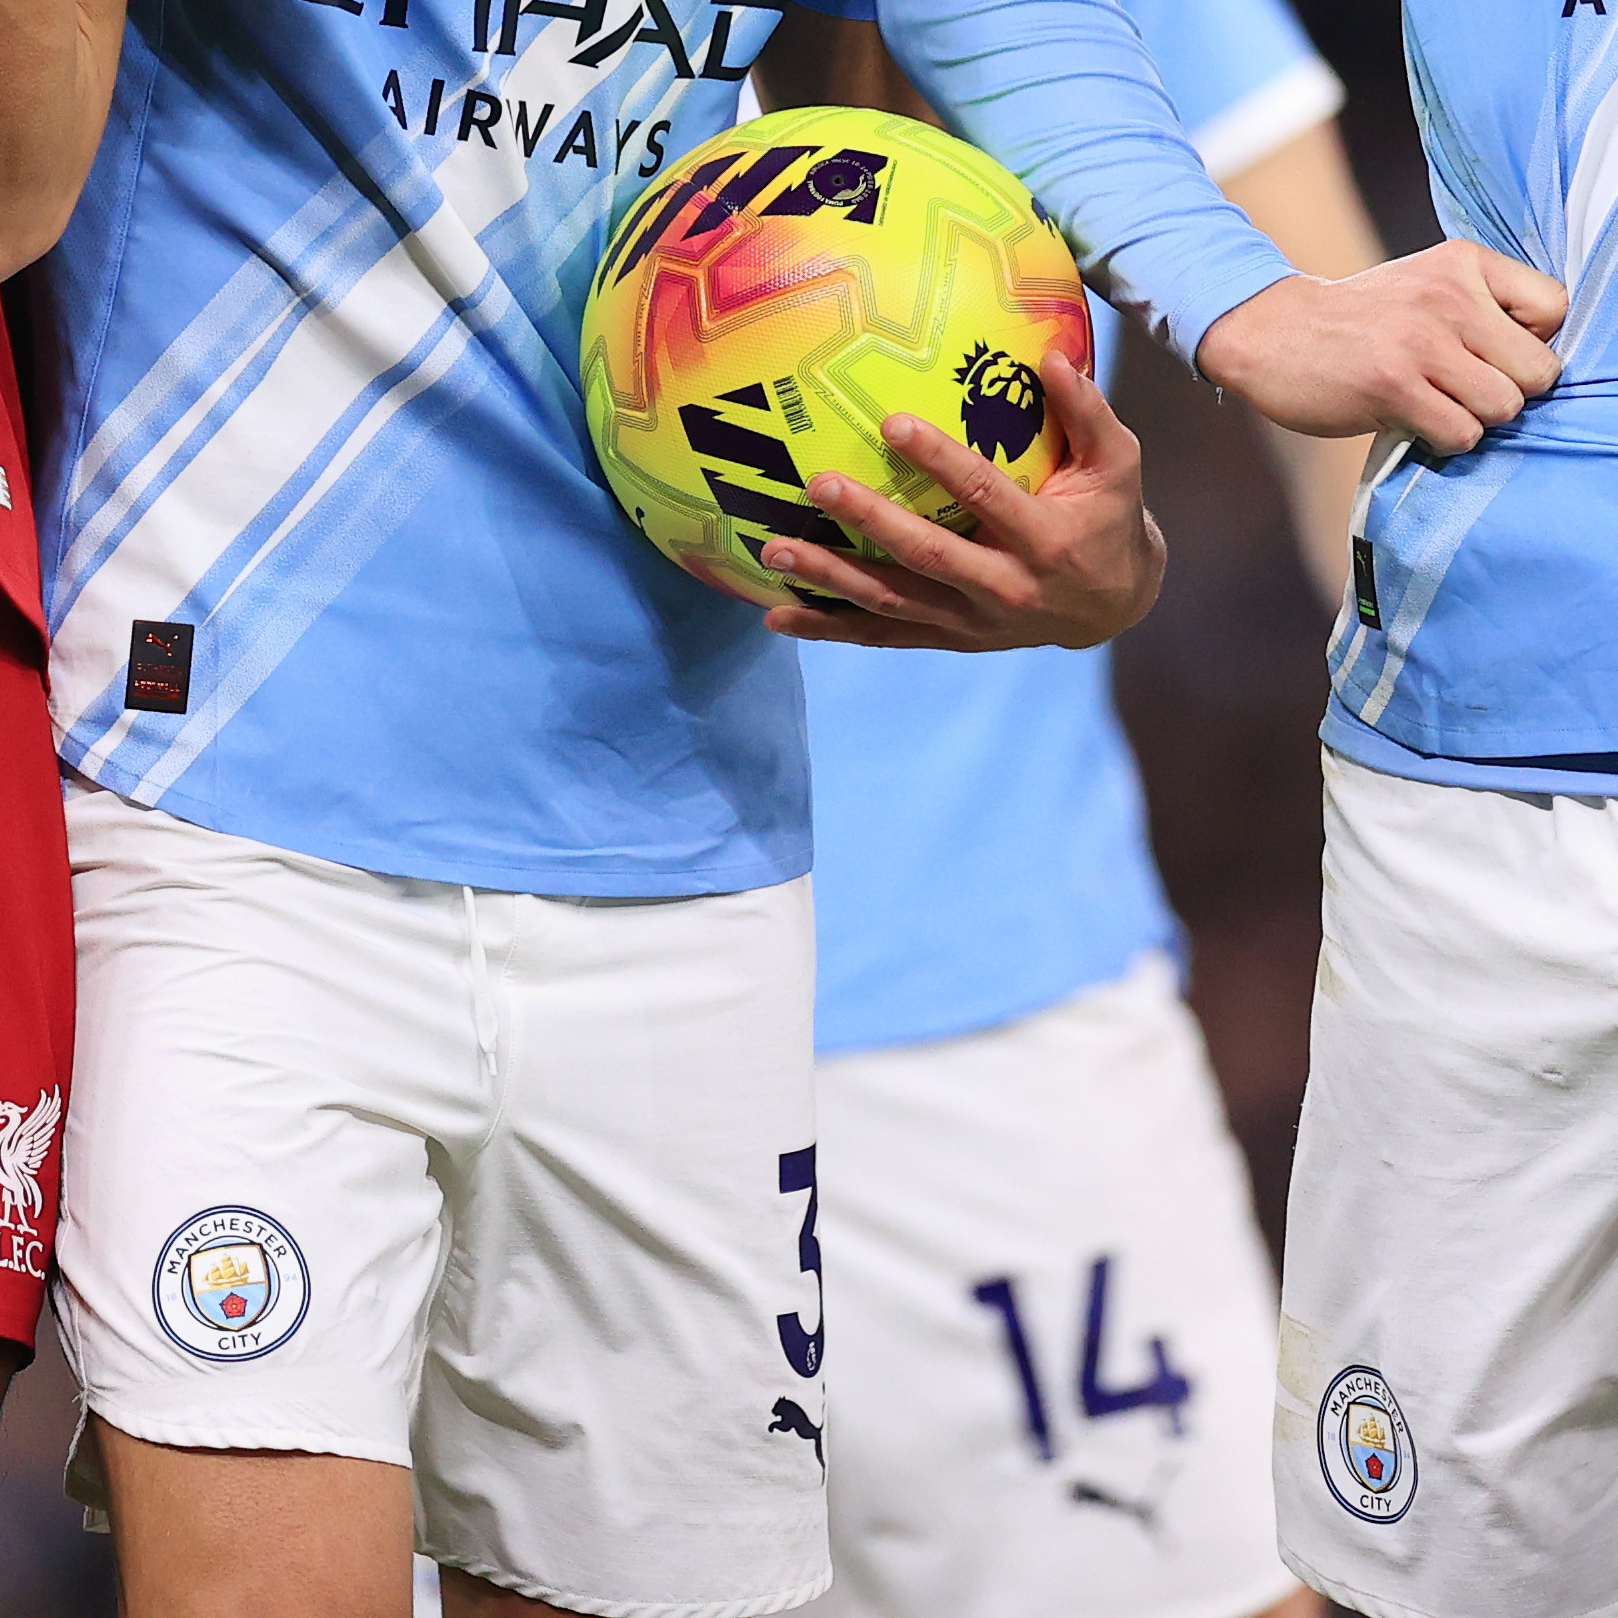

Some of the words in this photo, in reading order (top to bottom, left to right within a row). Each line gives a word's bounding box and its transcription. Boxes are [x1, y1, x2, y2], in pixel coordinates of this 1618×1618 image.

[382, 69, 671, 178] AIRWAYS
[167, 1218, 288, 1275] MANCHESTER
[776, 1140, 825, 1379] 3
[218, 1332, 263, 1351] CITY
[972, 1254, 1192, 1463] 14
[1330, 1377, 1405, 1434] MANCHESTER
[1359, 1494, 1392, 1513] CITY
